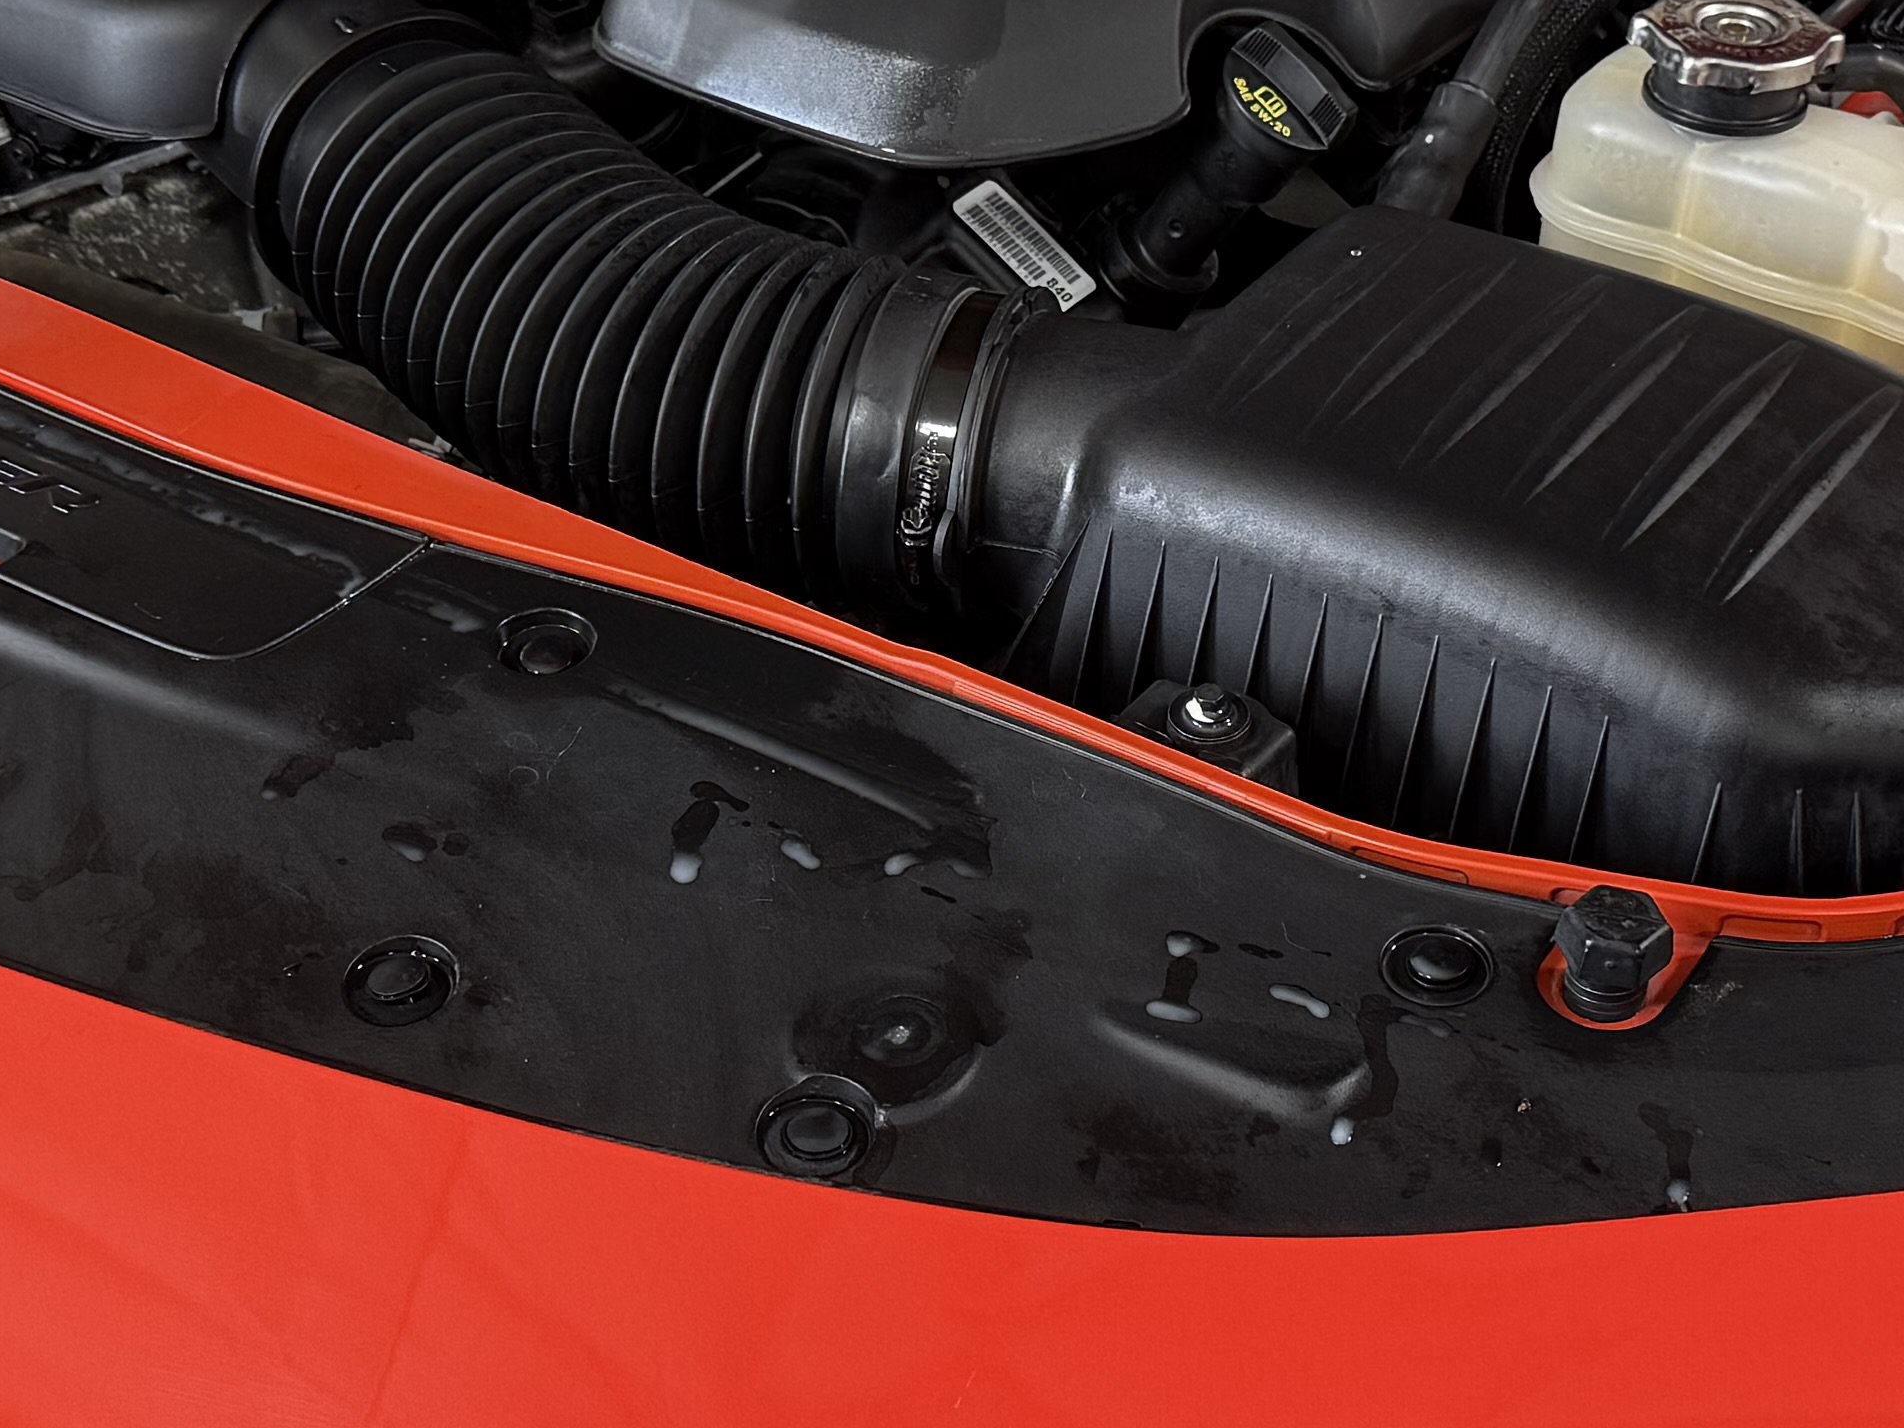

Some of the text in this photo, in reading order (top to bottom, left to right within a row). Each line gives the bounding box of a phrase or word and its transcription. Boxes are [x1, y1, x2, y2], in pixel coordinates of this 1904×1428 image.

[1233, 77, 1291, 138] SAE 5W-20
[1046, 277, 1073, 304] 840
